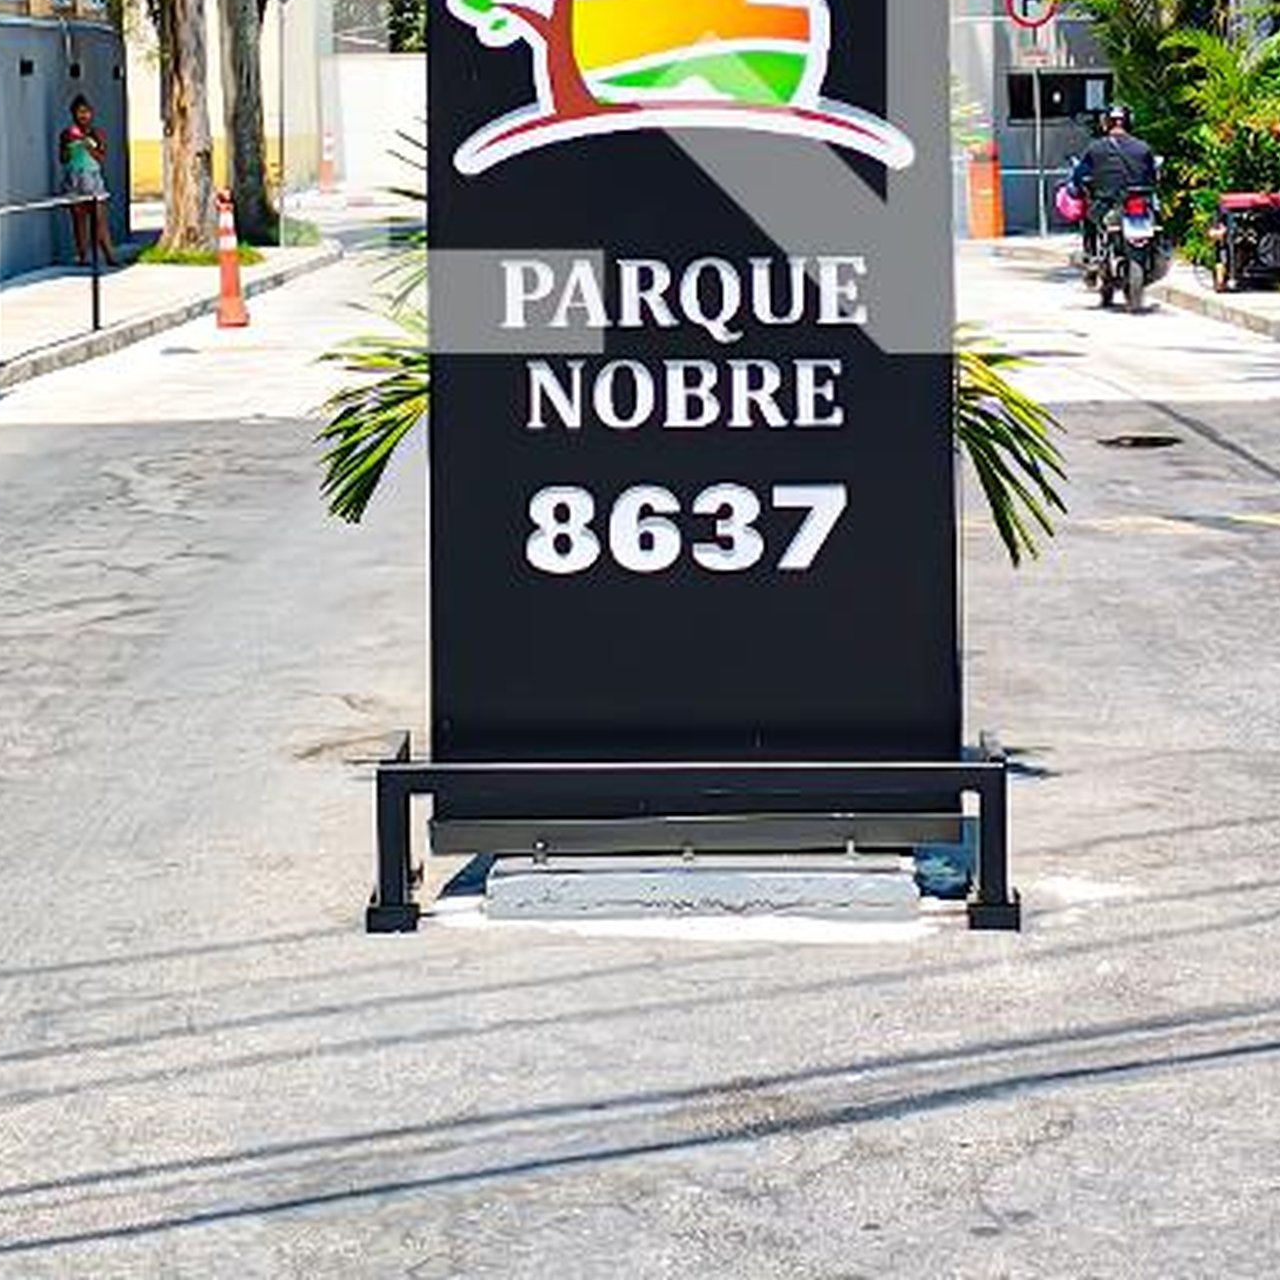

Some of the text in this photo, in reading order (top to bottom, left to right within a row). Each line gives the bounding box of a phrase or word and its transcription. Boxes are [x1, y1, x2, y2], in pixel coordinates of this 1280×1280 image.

[500, 256, 868, 343] PARQUE
[526, 359, 845, 428] NOBRE
[526, 483, 847, 574] 8637
